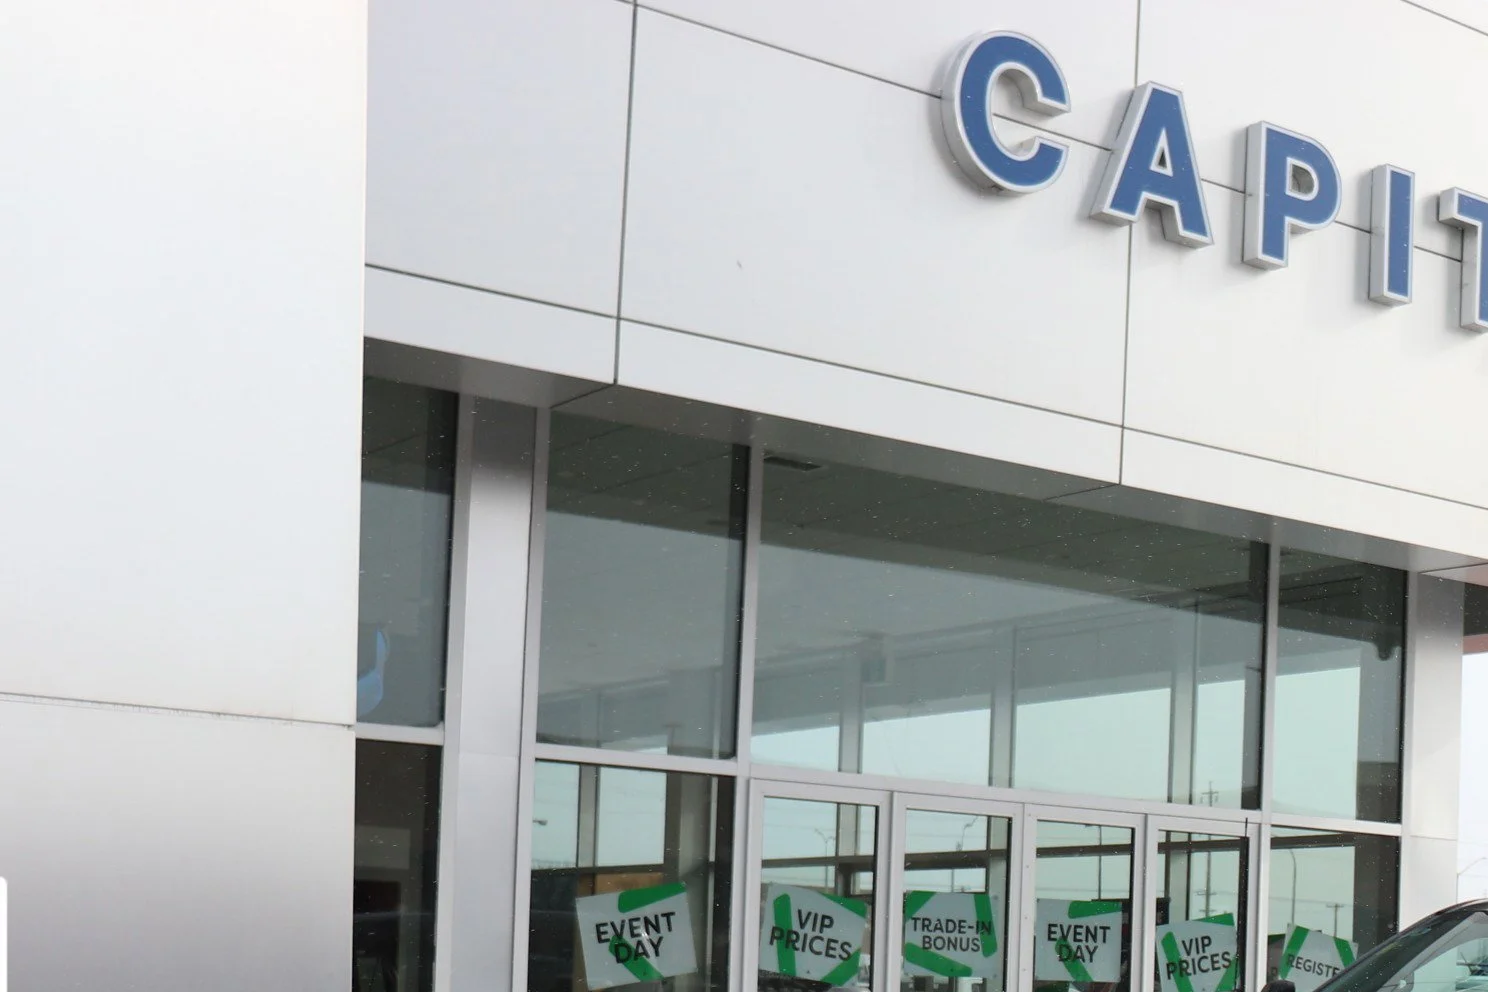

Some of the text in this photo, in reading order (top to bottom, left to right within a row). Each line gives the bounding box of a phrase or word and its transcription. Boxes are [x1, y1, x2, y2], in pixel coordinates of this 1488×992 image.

[595, 911, 676, 944] EVENT
[797, 908, 834, 933] VIP
[911, 916, 992, 936] TRADE-IN
[769, 926, 853, 962] PRICES
[921, 934, 981, 953] BONUS
[1047, 923, 1111, 944] EVENT
[614, 936, 664, 965] DAY
[1058, 943, 1097, 963] DAY
[1181, 935, 1213, 957] VIP
[1166, 950, 1232, 981] PRICES
[1287, 954, 1341, 978] REGISTE
